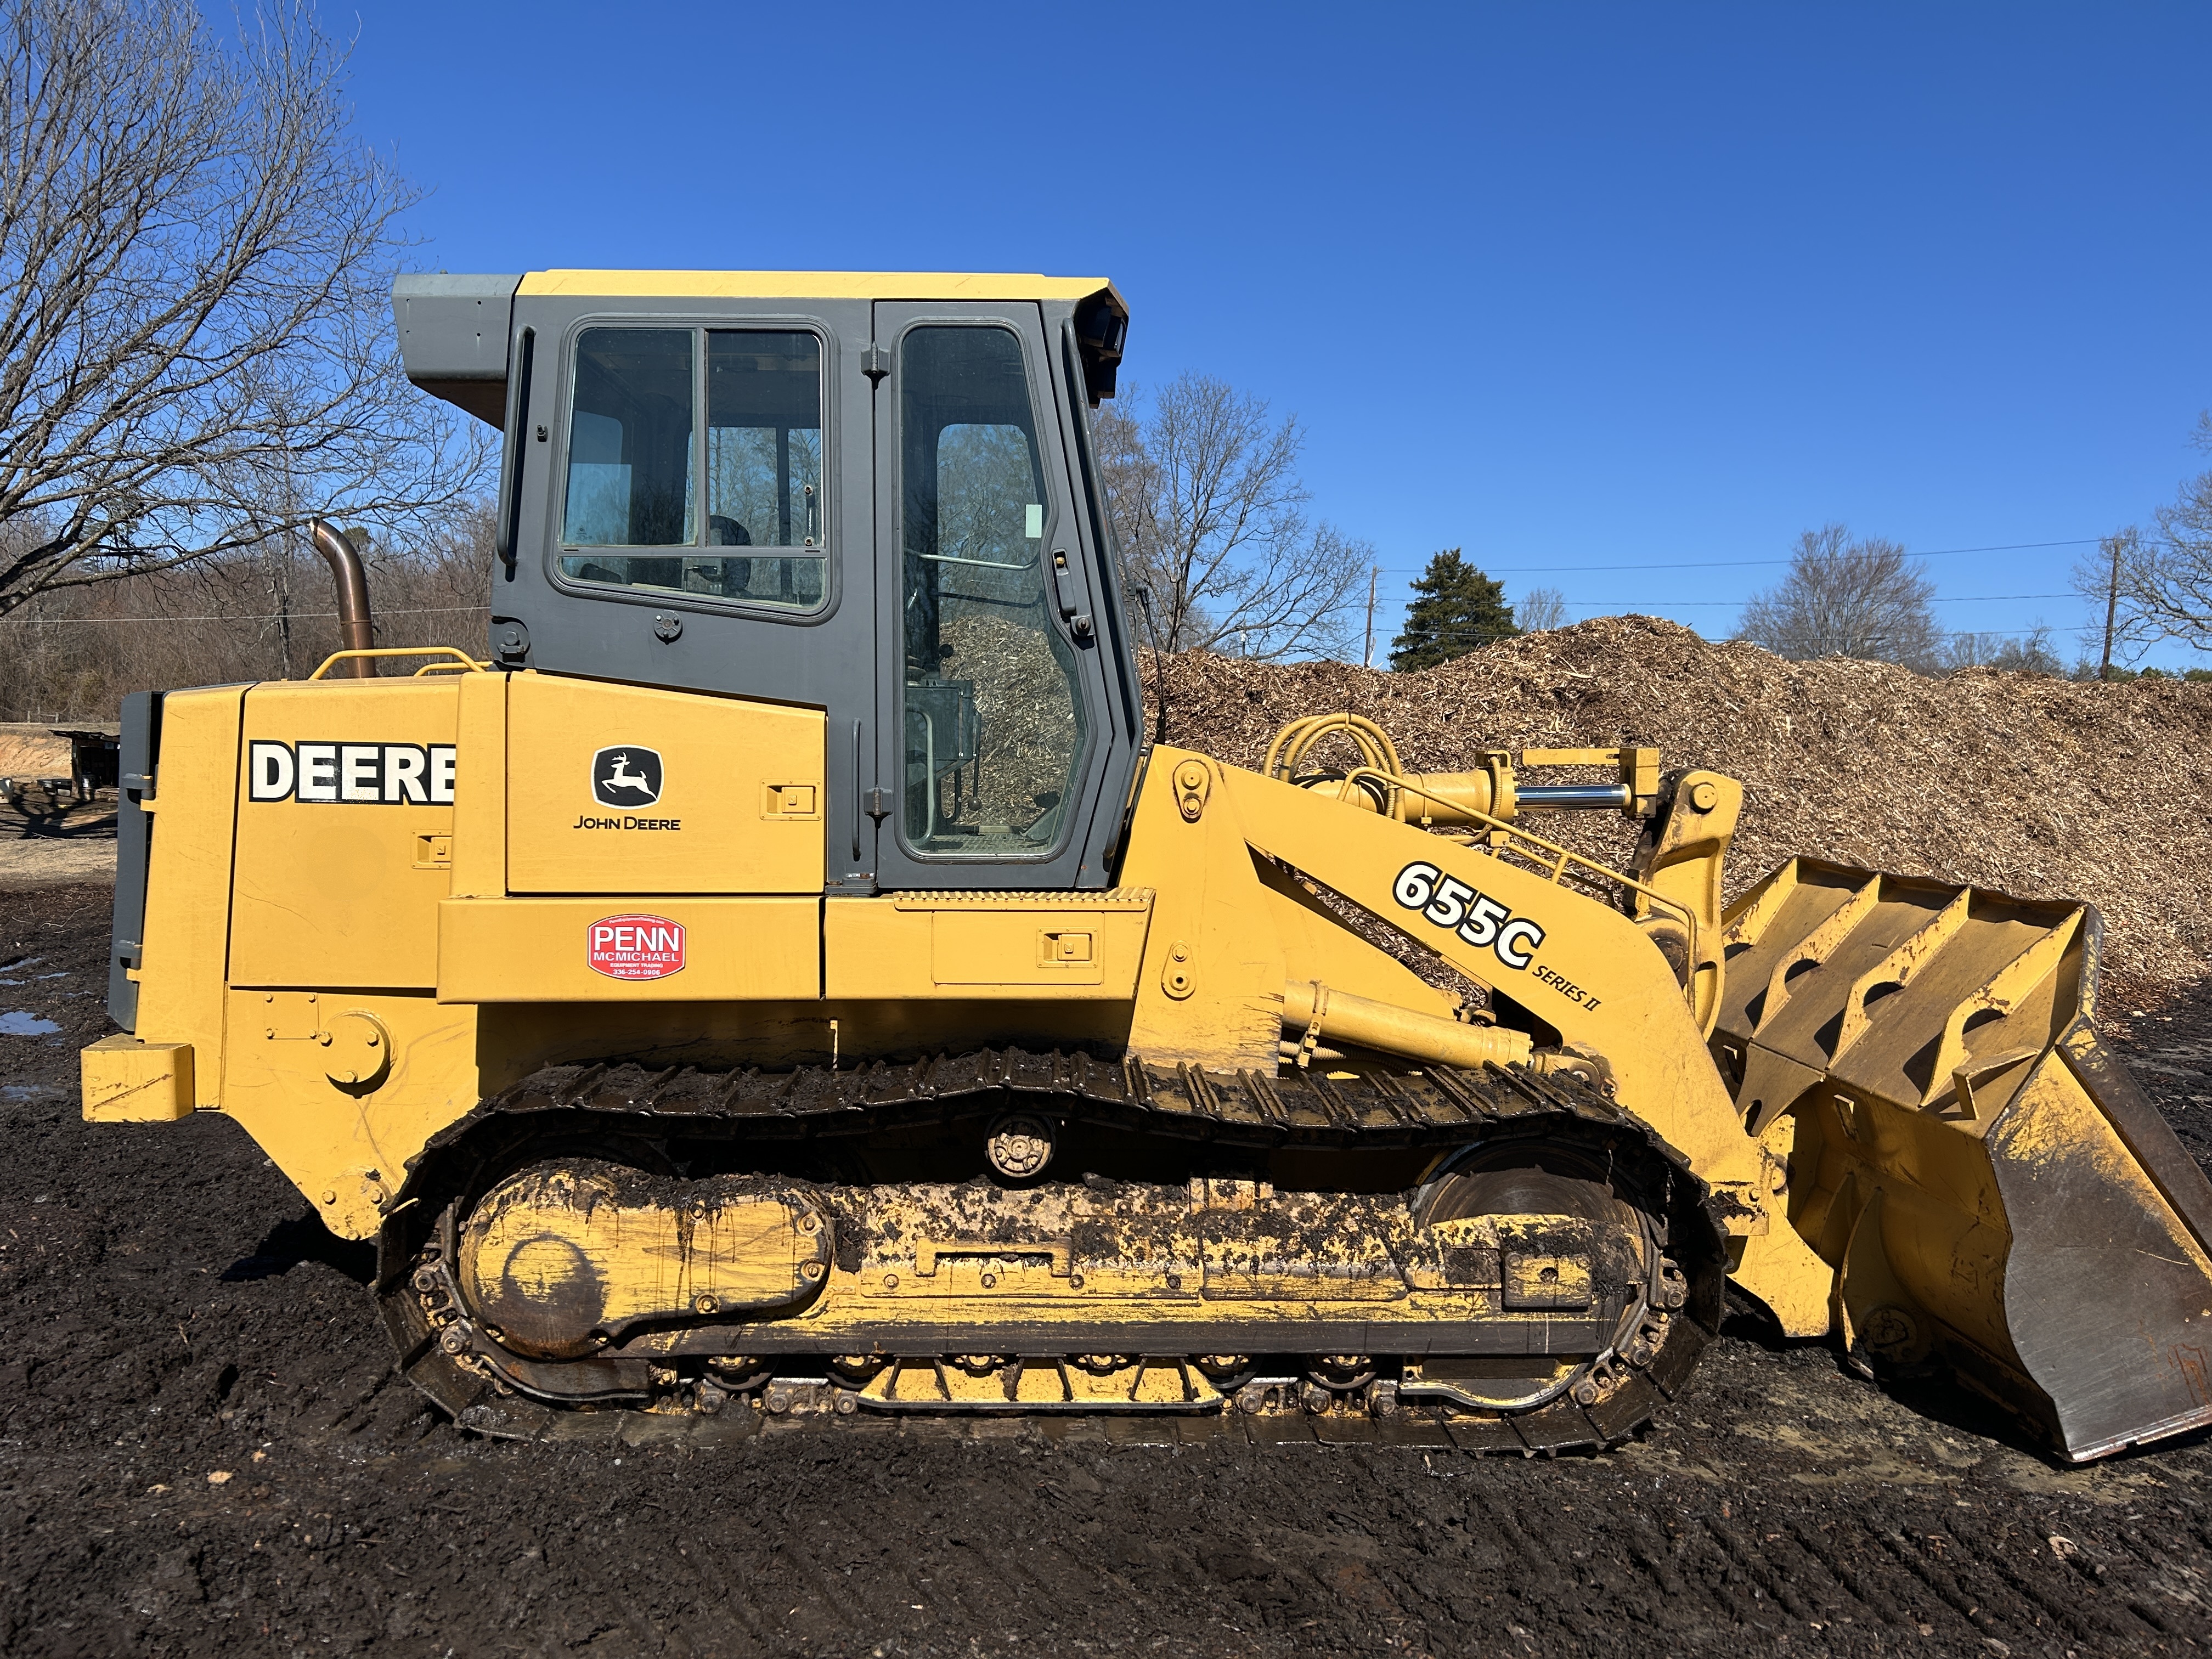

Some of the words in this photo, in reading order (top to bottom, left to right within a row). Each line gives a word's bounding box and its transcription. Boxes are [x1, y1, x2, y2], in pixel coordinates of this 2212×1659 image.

[250, 740, 456, 806] DEERE
[573, 815, 620, 830] JOHN
[624, 816, 681, 831] DEERE
[1392, 860, 1547, 970] 655C
[595, 927, 679, 951] PENN
[594, 952, 680, 962] MCMICHAEL
[1532, 965, 1587, 1002] SERIES
[1583, 996, 1601, 1012] II
